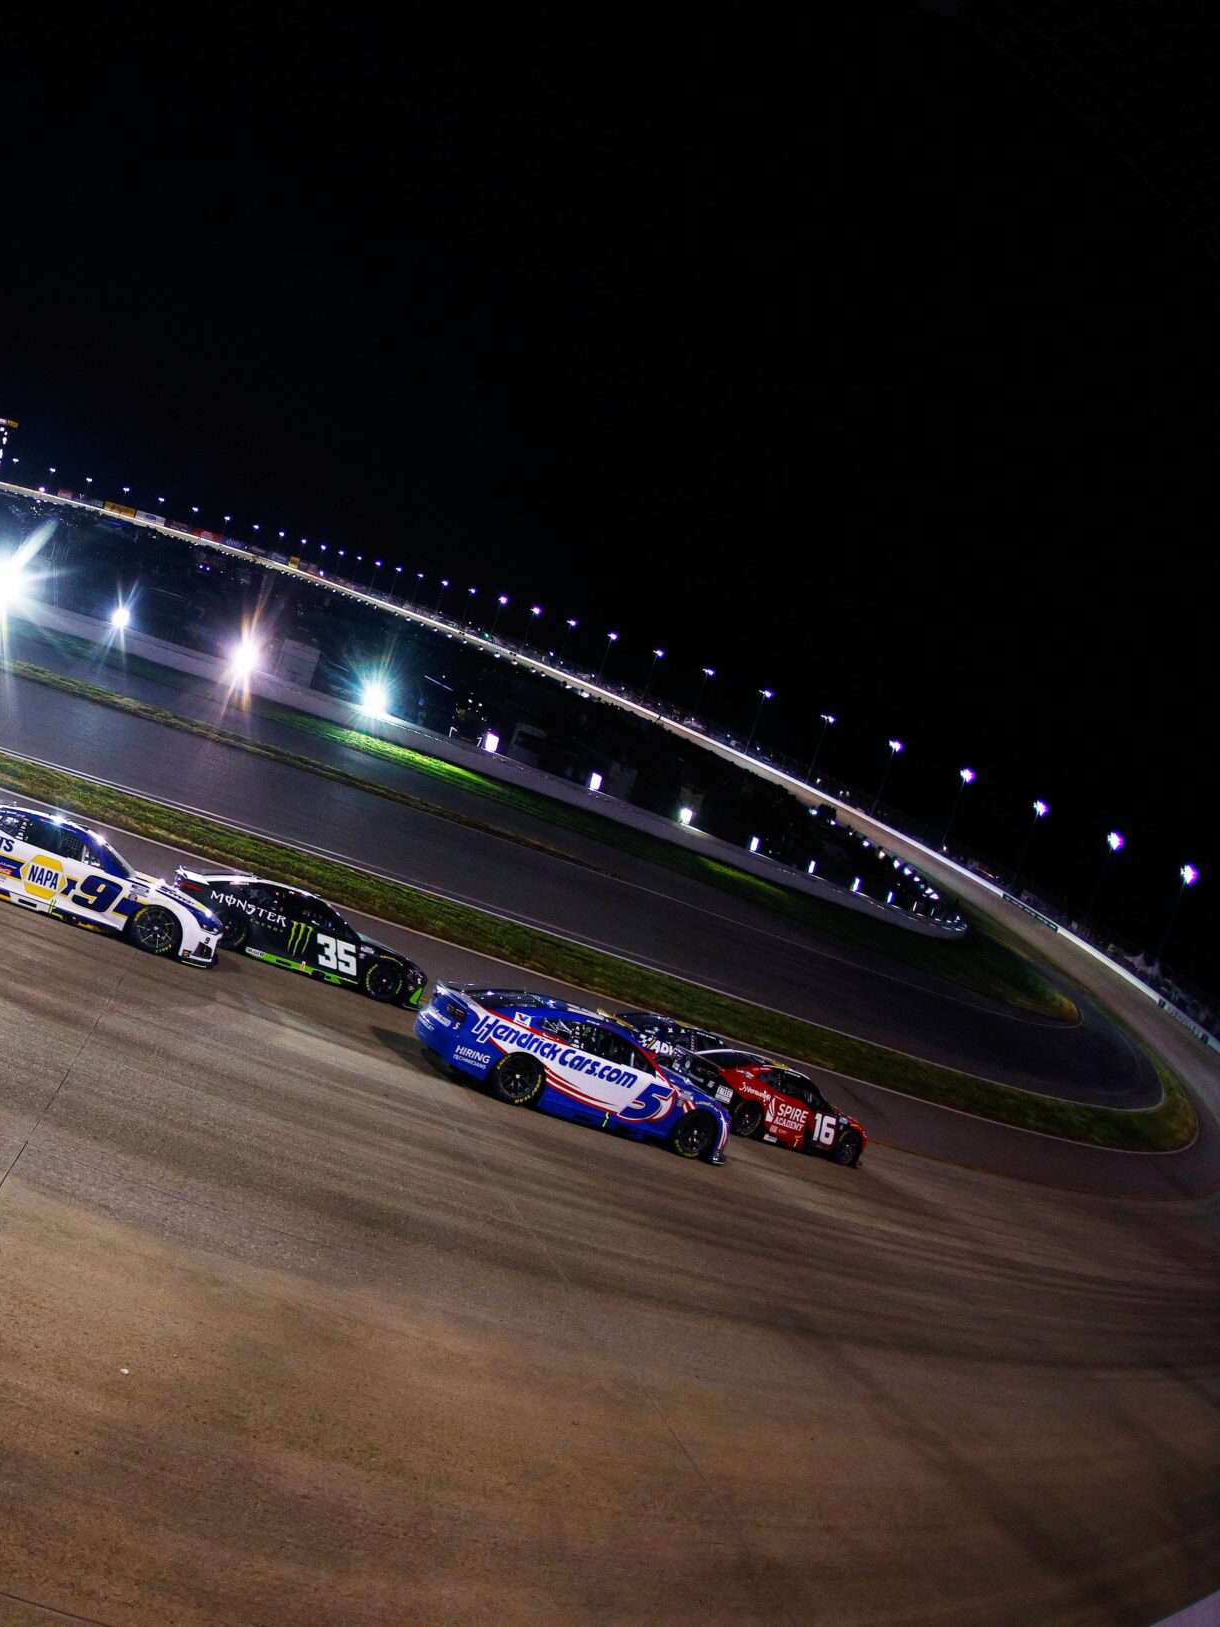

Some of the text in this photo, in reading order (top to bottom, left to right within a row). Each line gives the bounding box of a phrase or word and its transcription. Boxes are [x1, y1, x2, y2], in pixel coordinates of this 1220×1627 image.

[27, 865, 60, 890] NAPA
[71, 874, 124, 913] 9
[210, 890, 287, 928] MONSTER
[204, 936, 211, 944] 9
[317, 933, 357, 977] 35
[452, 1022, 460, 1030] 5
[453, 1054, 487, 1070] TECHNICIANS
[455, 1045, 491, 1064] HIRING
[617, 1083, 676, 1121] 5
[777, 1103, 809, 1124] SPIRE
[773, 1116, 804, 1132] ACADEMY
[812, 1112, 837, 1146] 16
